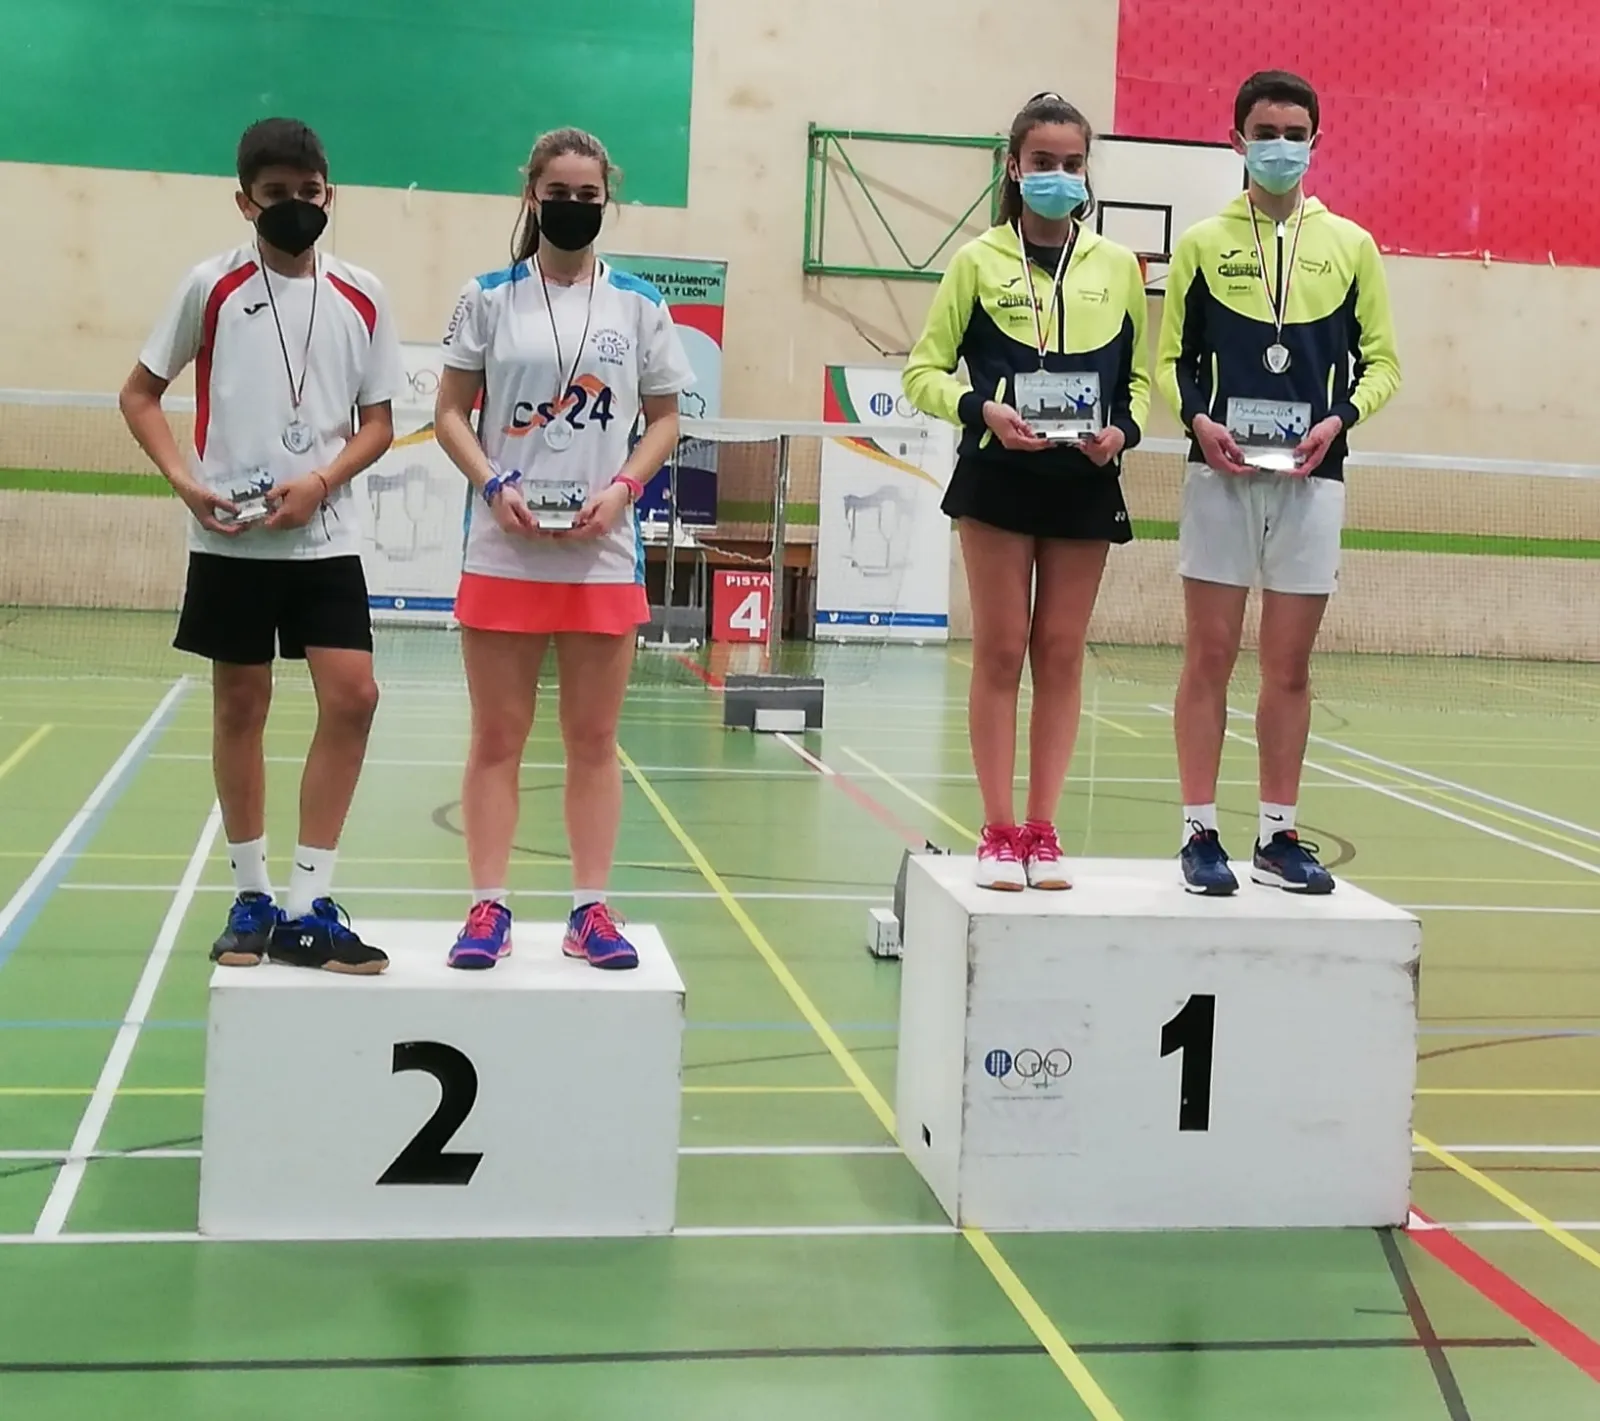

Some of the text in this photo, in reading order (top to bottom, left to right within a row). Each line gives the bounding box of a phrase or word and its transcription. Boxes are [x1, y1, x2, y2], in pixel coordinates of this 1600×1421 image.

[656, 274, 667, 284] DE
[674, 287, 681, 297] Y
[682, 286, 708, 299] LEÓN
[726, 574, 770, 587] PISTA
[729, 591, 767, 638] 4
[1160, 994, 1216, 1132] 1
[375, 1041, 484, 1186] 2
